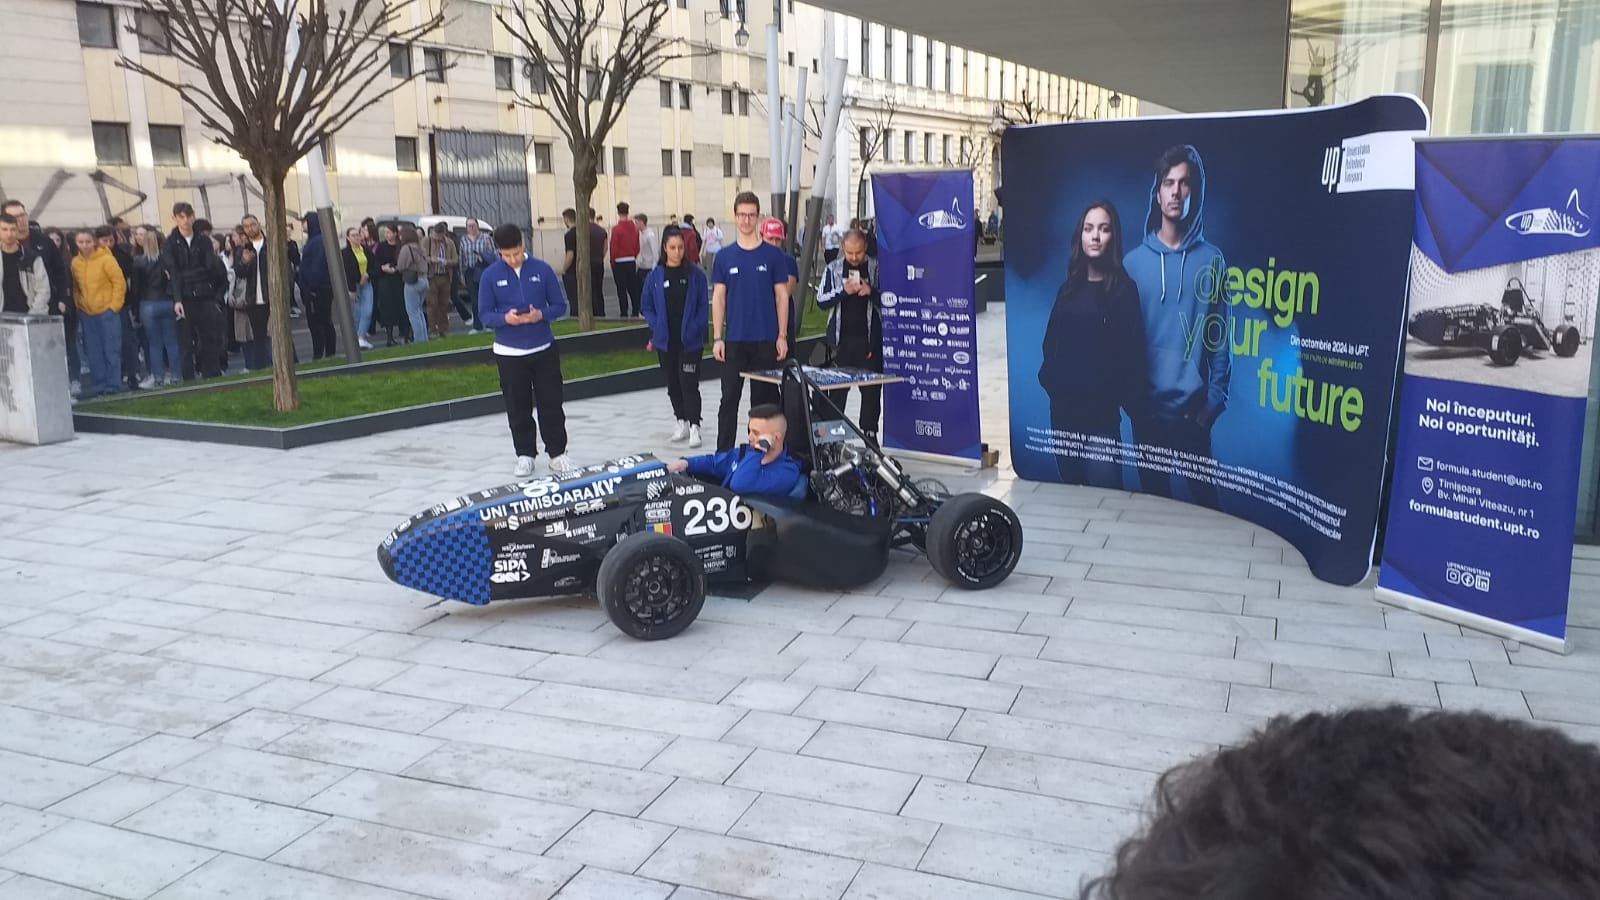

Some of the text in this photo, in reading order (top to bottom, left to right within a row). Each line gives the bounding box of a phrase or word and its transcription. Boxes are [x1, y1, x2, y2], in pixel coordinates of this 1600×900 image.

[1193, 255, 1320, 328] design
[1178, 311, 1268, 361] your
[1301, 338, 1332, 352] octombrie
[1332, 340, 1347, 354] 2024
[1257, 357, 1364, 432] future
[1419, 414, 1444, 430] Noi
[1426, 397, 1536, 428] Noi începuturi.
[637, 468, 666, 480] MOTUL
[1436, 460, 1544, 492] formula.student@upt.ro
[480, 504, 508, 521] UNI
[510, 487, 593, 514] TIMISOARA
[683, 495, 752, 536] 236
[1408, 499, 1541, 540] formulastudent.upt.ro
[1437, 489, 1535, 520] Bv. Mihai Viteazu, nr 1
[494, 558, 528, 573] SIPA
